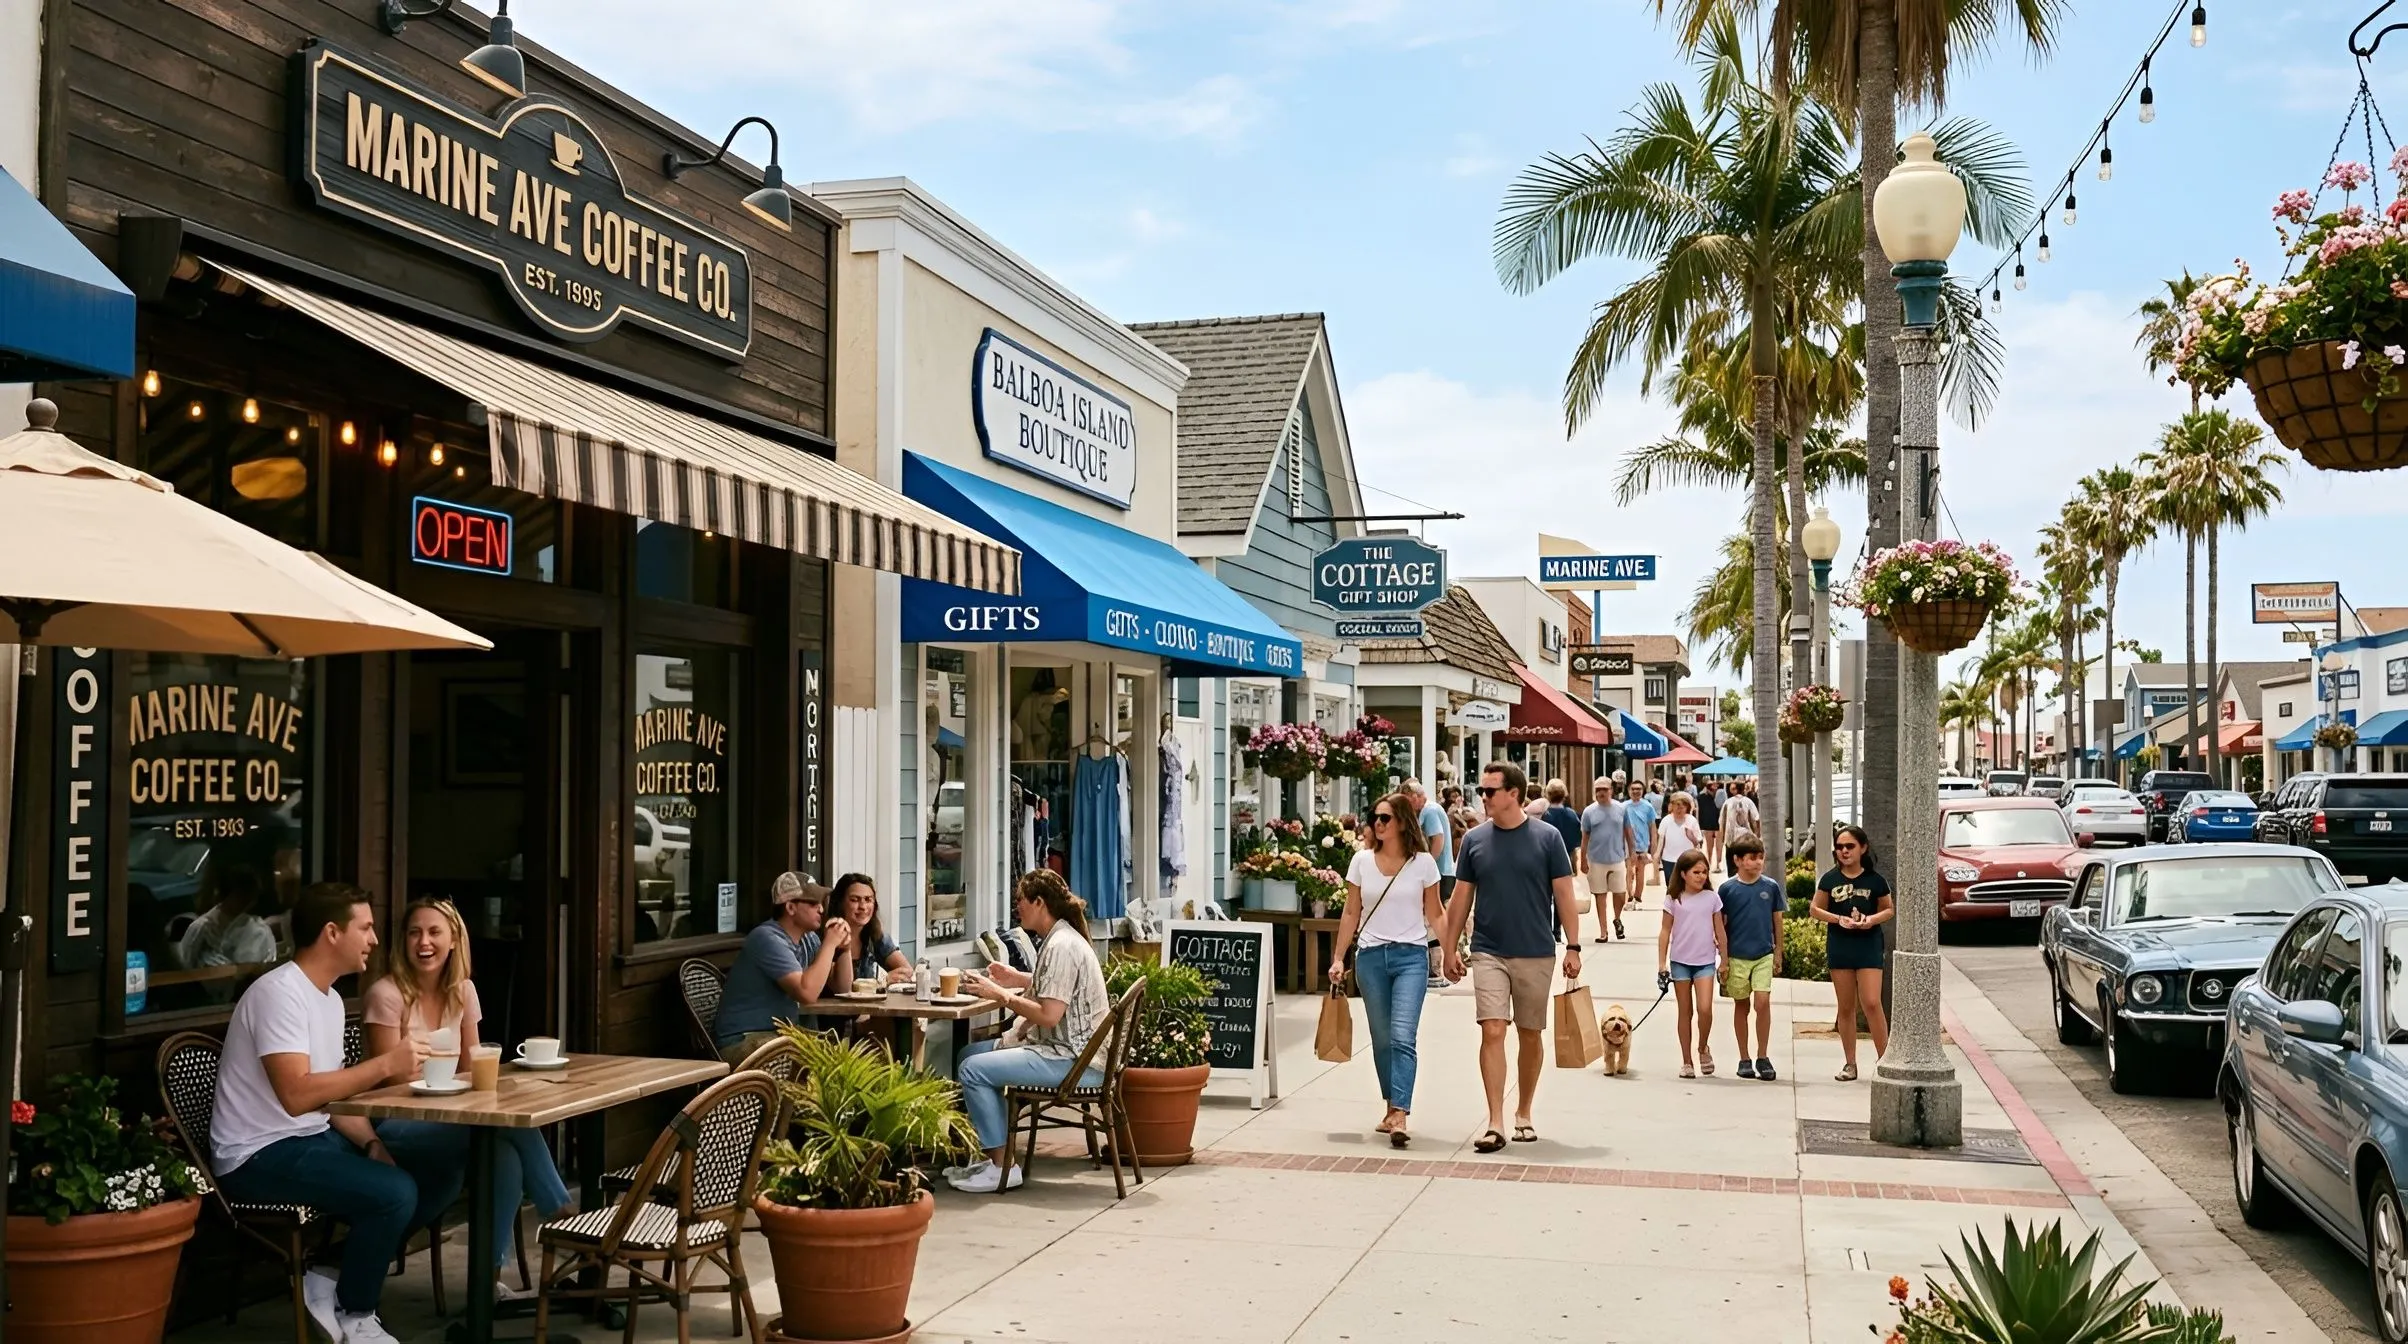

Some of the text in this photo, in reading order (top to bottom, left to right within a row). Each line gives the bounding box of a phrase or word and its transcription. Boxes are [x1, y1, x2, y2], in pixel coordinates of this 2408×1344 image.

[345, 90, 737, 323] MARINE AVE COFFEE CO.
[525, 262, 560, 296] EST.
[992, 351, 1129, 450] BALBOA ISLAND
[1019, 412, 1108, 483] BOUTIQUE
[417, 506, 507, 568] OPEN
[1320, 562, 1436, 588] COTTAGE
[1545, 558, 1649, 578] MARINE AVE.
[943, 606, 1040, 632] GIFTS
[1377, 590, 1419, 604] SHOP
[246, 692, 303, 753] AVE
[696, 712, 727, 756] AVE
[66, 646, 99, 937] OFFEE
[130, 758, 288, 804] COFFEE CO.
[636, 760, 693, 796] COFFEE
[175, 818, 207, 839] EST.
